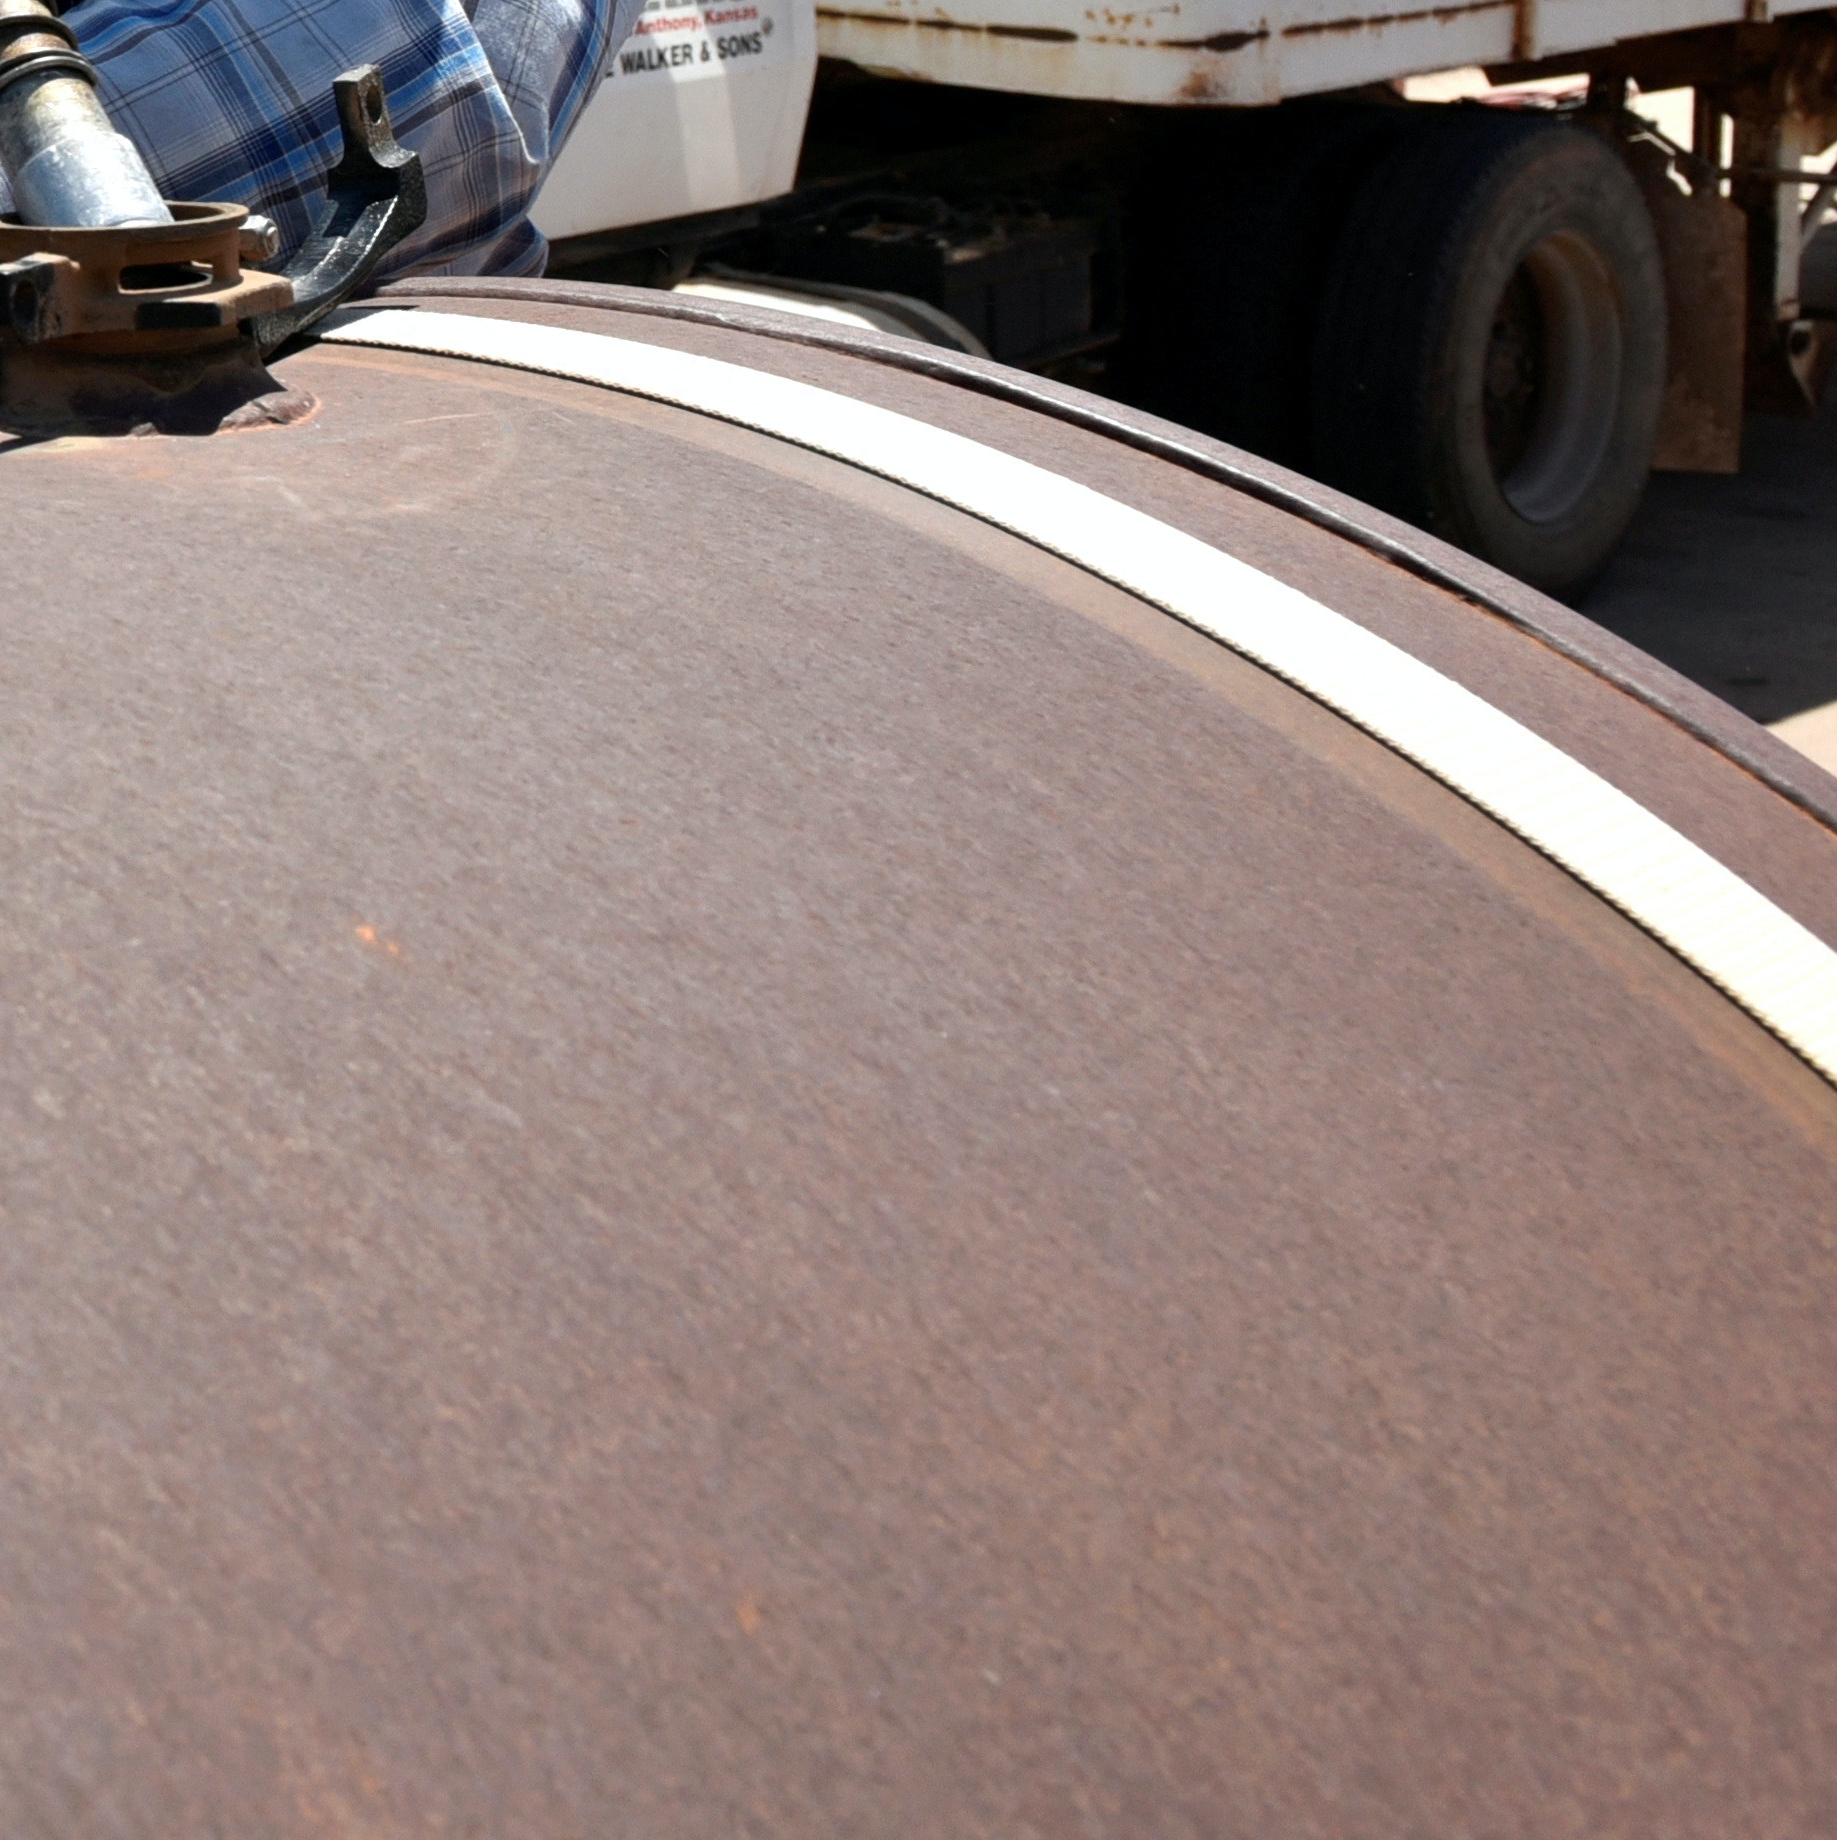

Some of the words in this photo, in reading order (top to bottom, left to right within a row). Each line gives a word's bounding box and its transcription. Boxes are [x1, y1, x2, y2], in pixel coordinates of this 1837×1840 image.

[704, 6, 759, 25] Kansas
[620, 43, 694, 75] WALKER
[700, 41, 710, 63] &
[716, 31, 764, 60] SONS
